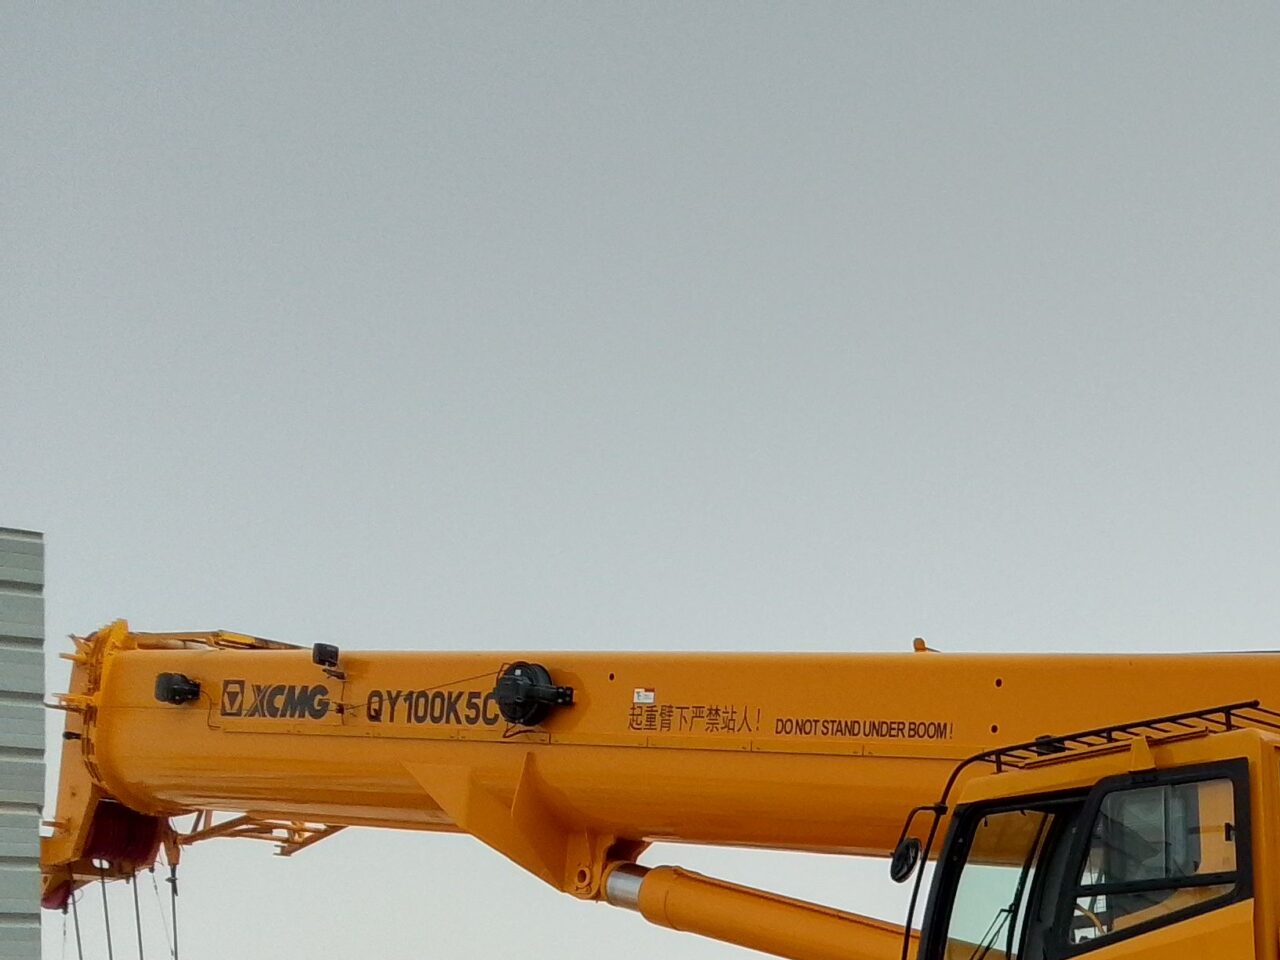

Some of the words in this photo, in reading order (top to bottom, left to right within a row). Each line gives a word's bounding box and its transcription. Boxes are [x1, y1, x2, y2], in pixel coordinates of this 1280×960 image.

[244, 683, 331, 720] XCMG
[366, 689, 500, 727] QY100K5C
[628, 703, 762, 734] 起重臂下严禁站人！
[775, 718, 794, 735] DO
[795, 718, 820, 736] NOT
[821, 719, 861, 737] STAND
[863, 720, 906, 738] UNDER
